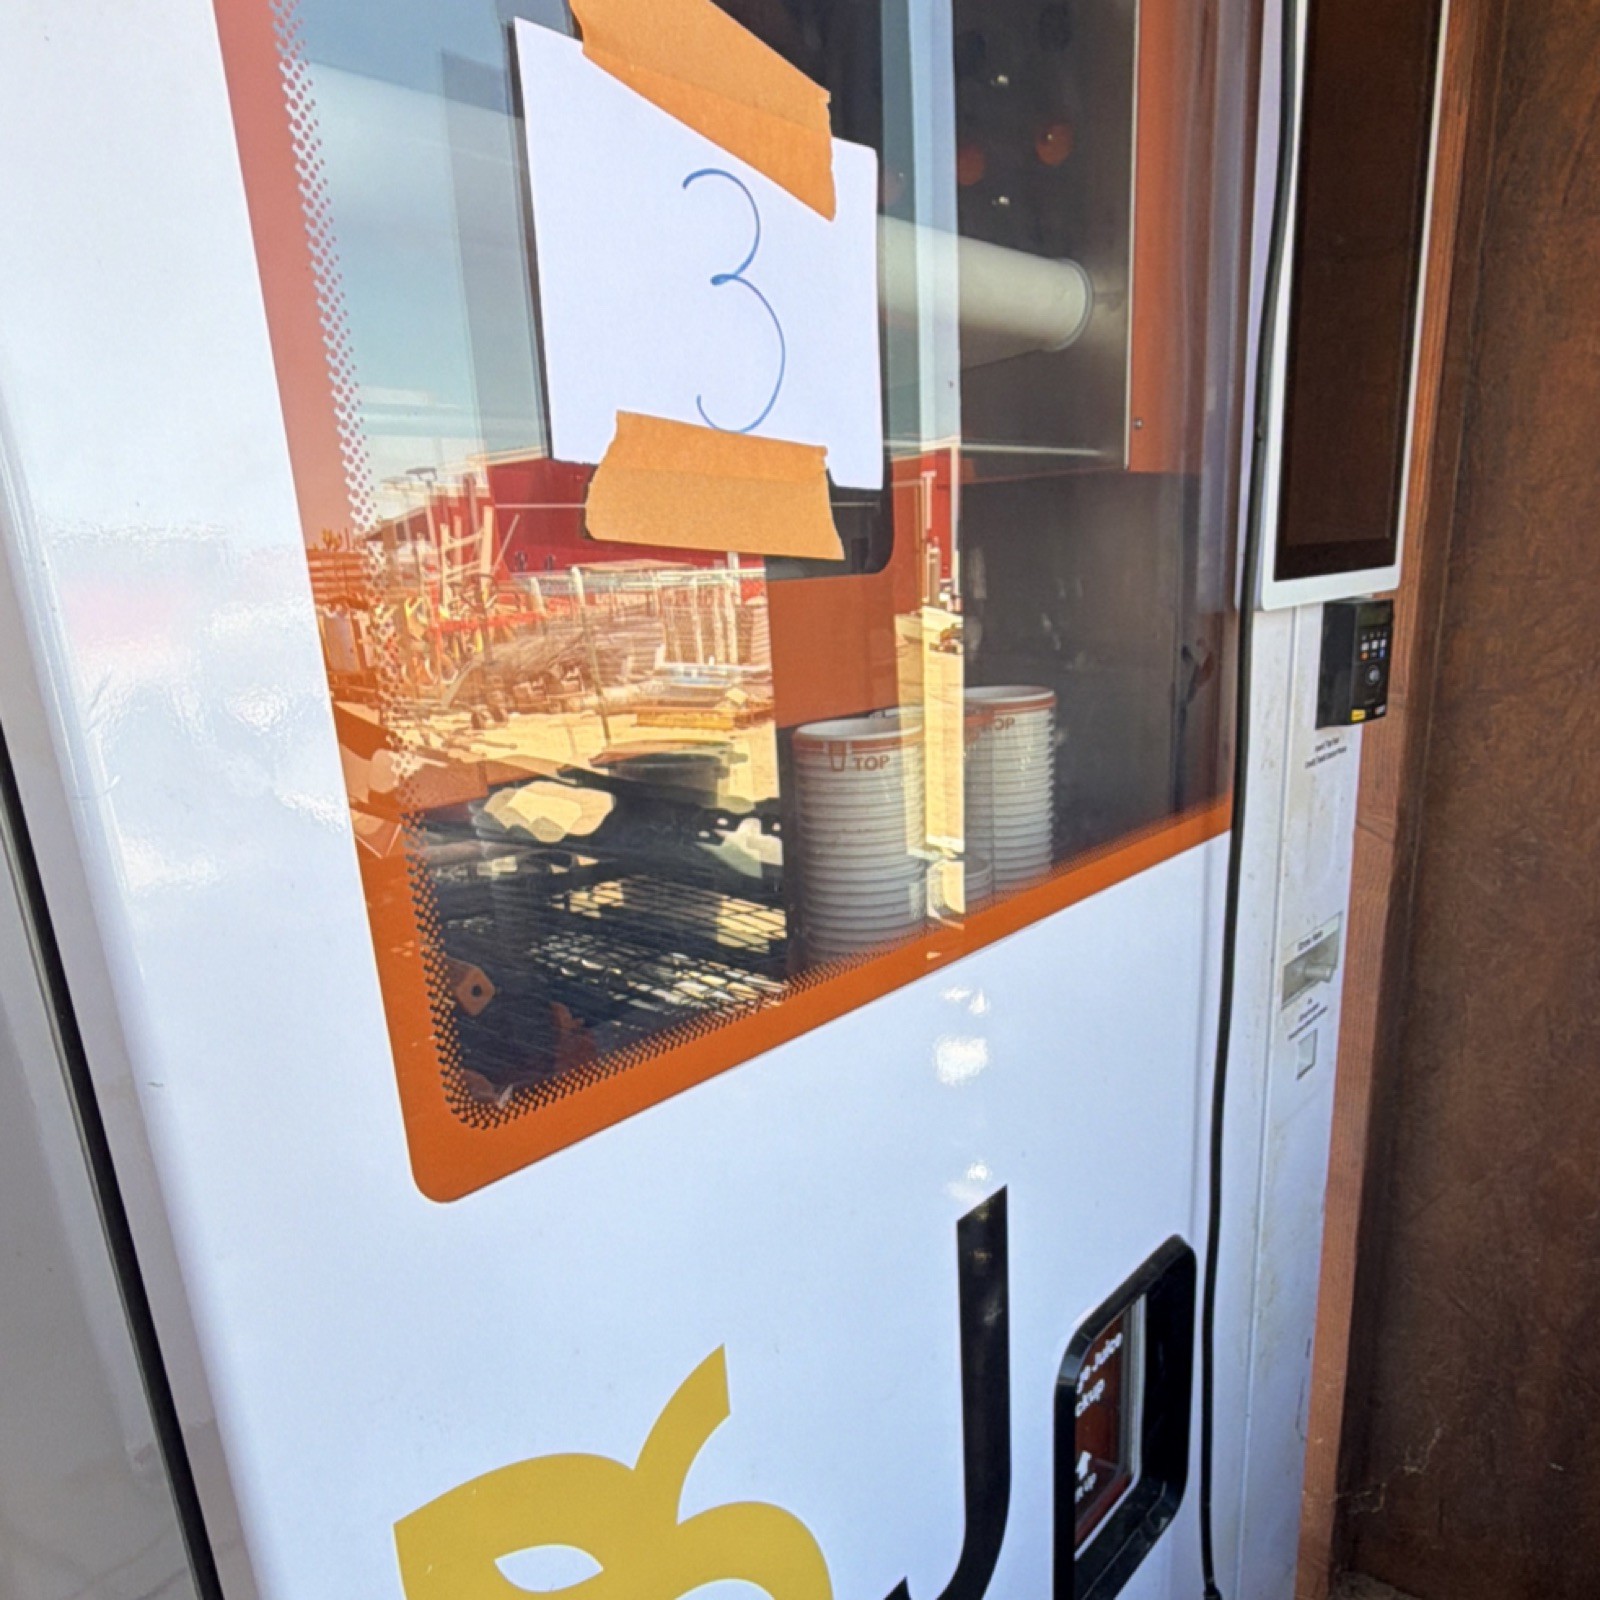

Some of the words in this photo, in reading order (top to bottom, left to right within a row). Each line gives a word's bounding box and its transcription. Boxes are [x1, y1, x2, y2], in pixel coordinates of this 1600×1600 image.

[682, 167, 786, 434] 3
[993, 716, 1016, 731] OP
[854, 754, 890, 772] TOP
[1075, 1378, 1105, 1418] ckup
